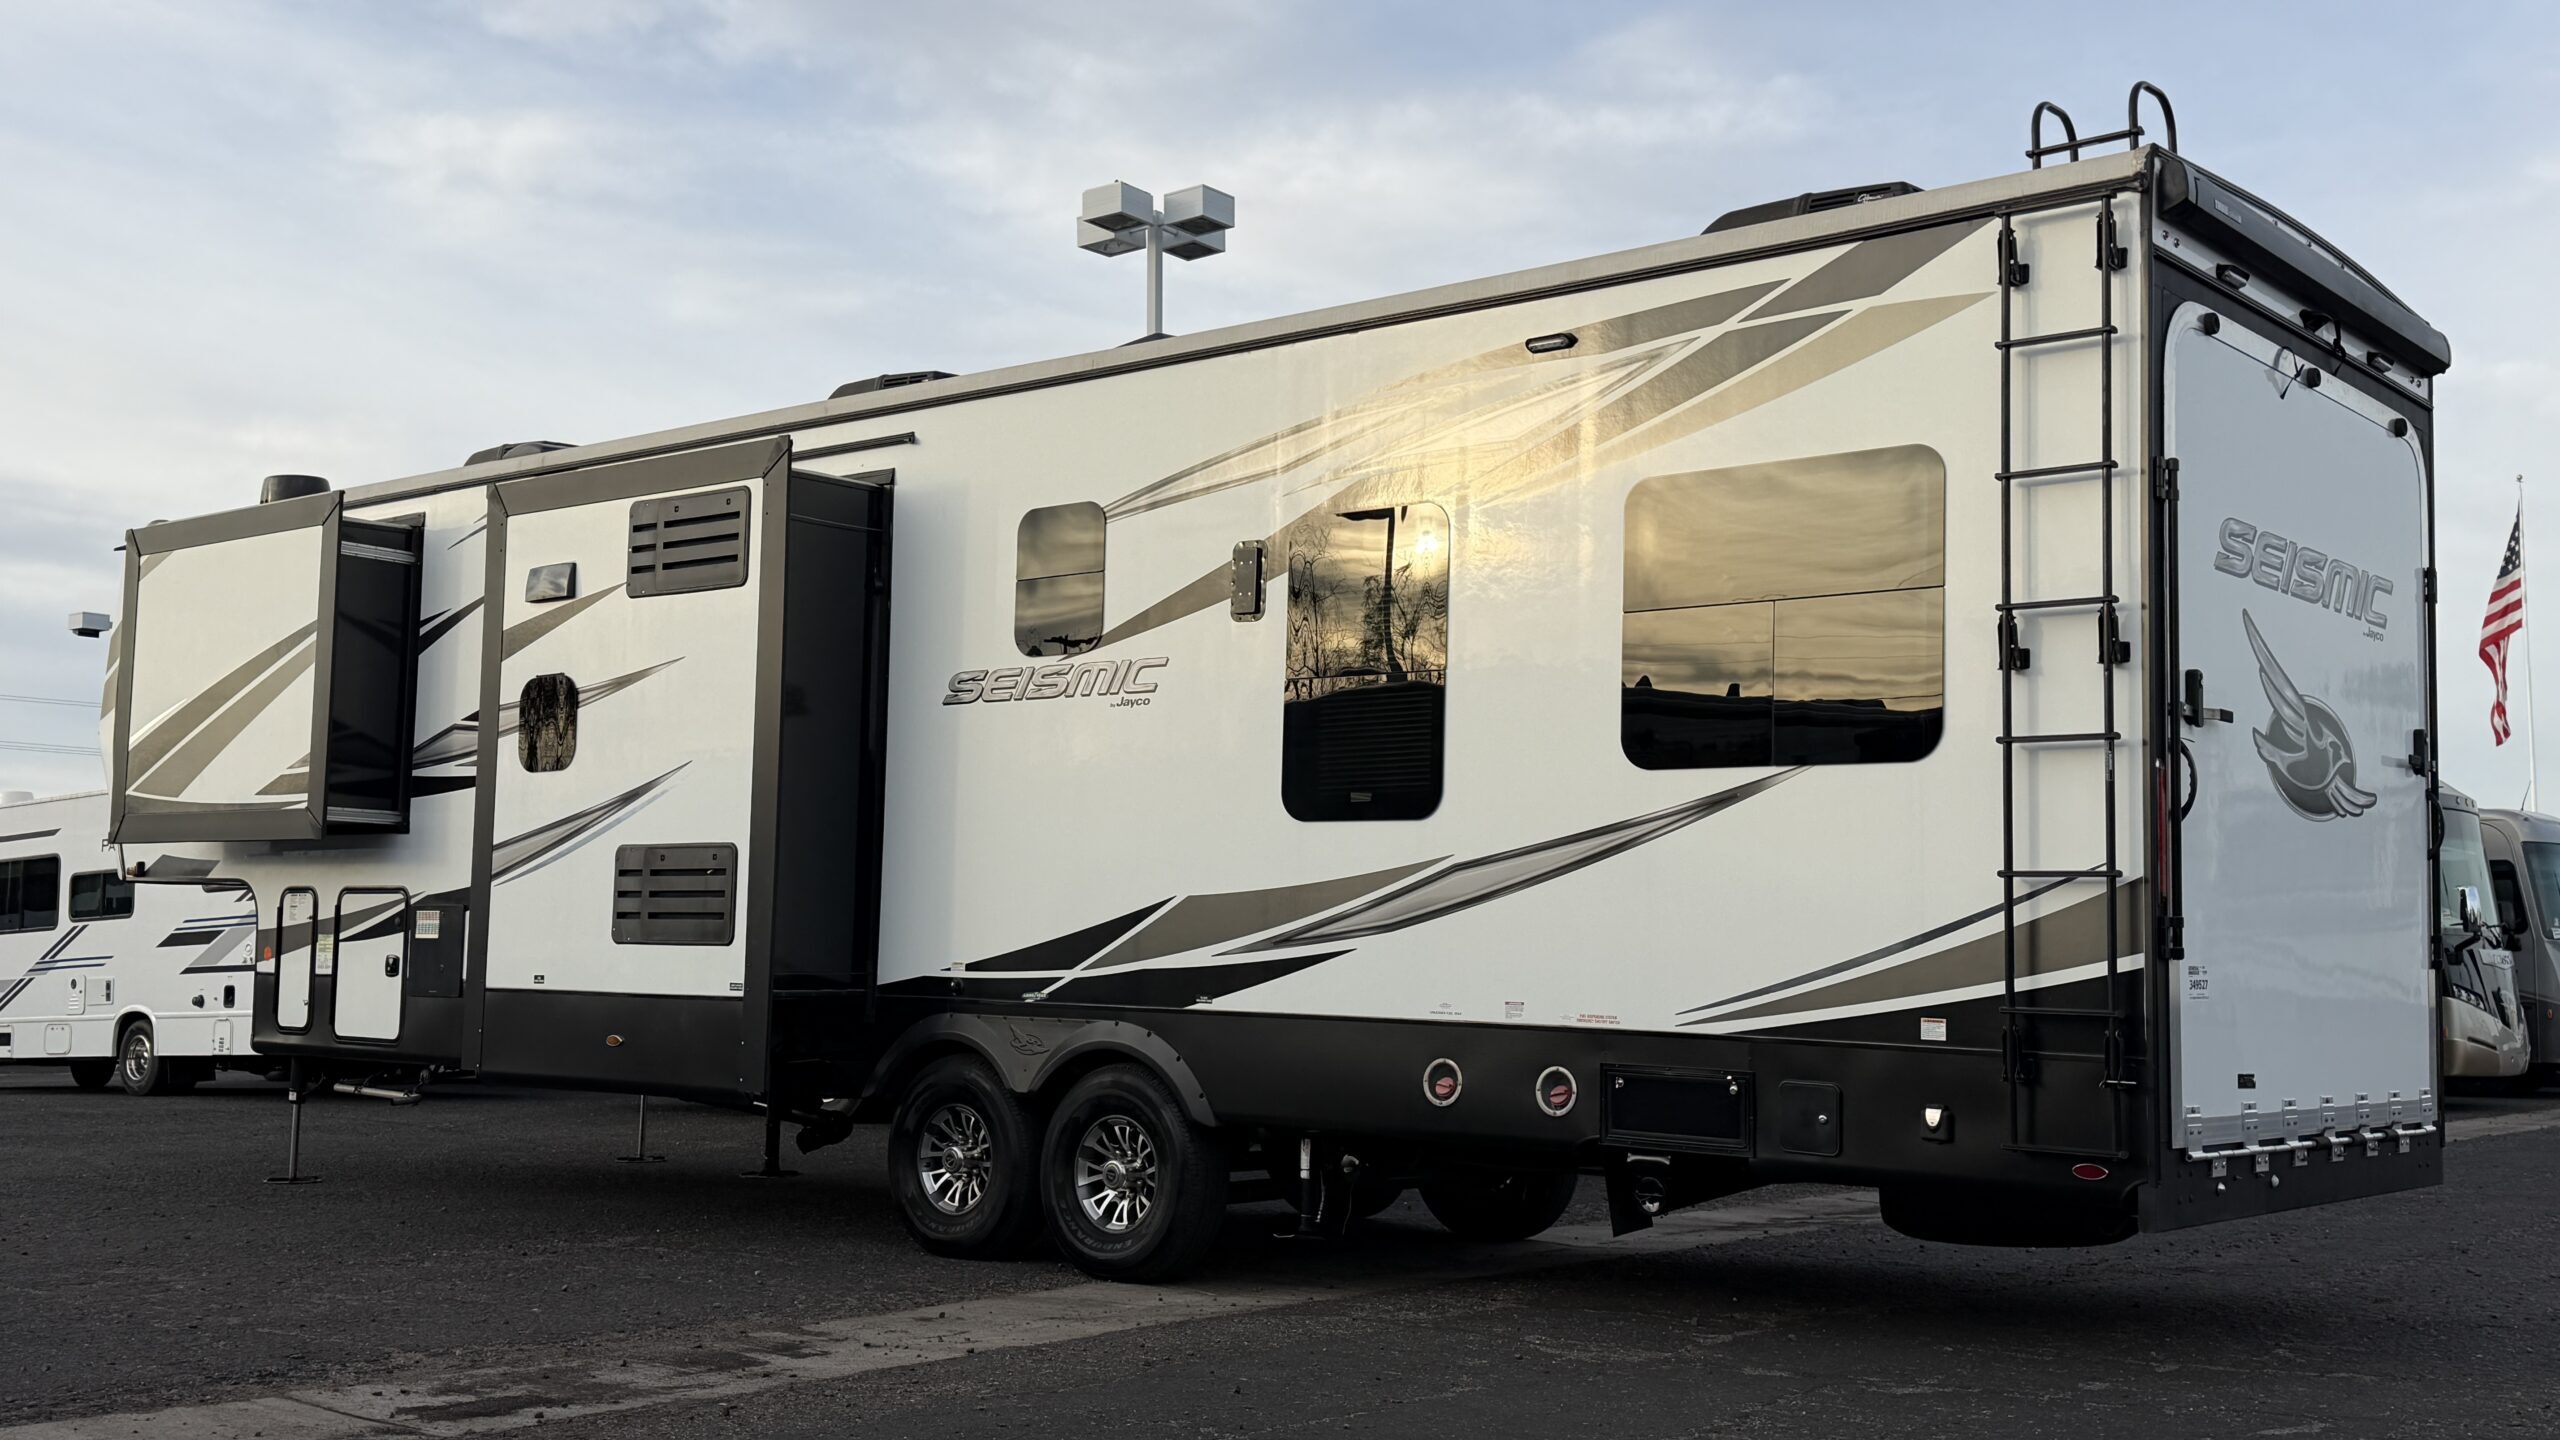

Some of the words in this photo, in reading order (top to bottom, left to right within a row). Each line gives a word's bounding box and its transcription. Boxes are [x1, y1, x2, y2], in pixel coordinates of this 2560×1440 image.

[2213, 517, 2394, 630] SEISMIC
[942, 656, 1169, 706] SEISMIC
[1116, 696, 1151, 708] Jayco
